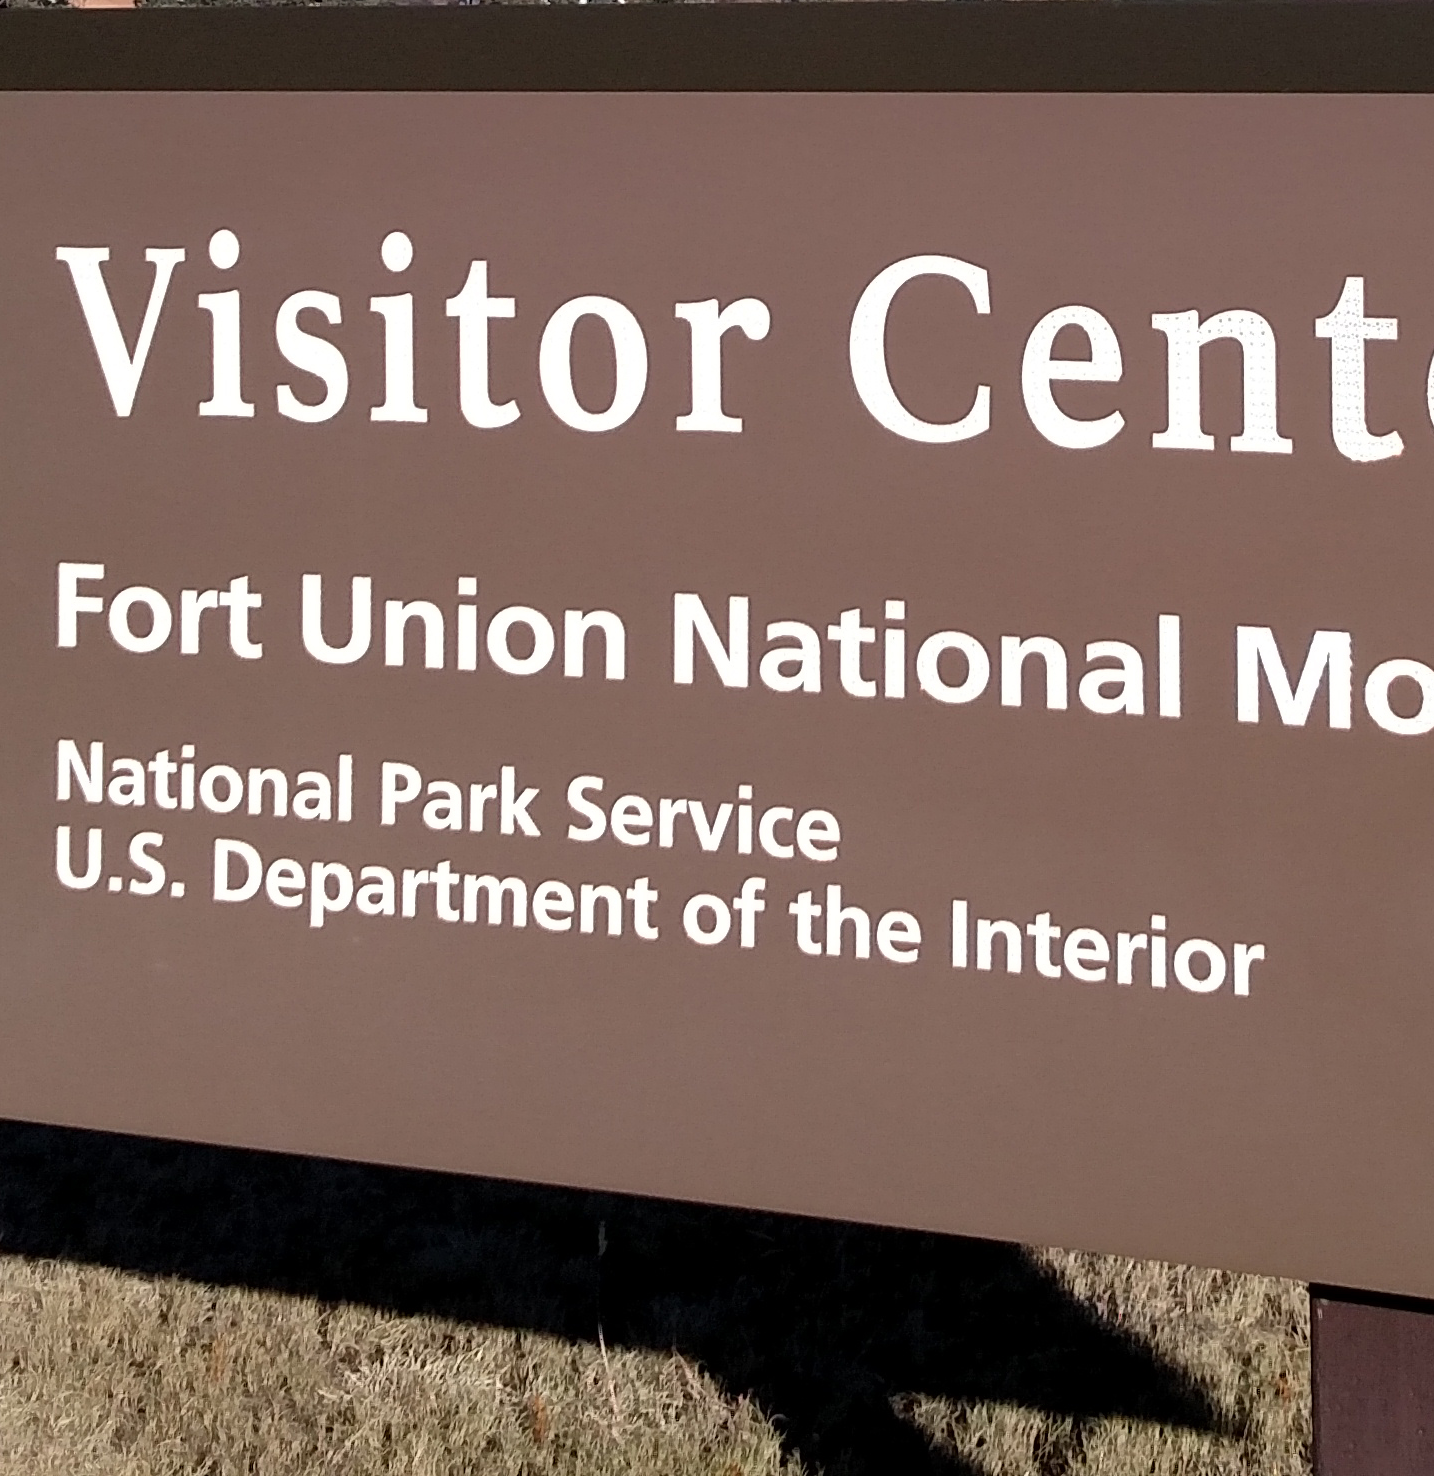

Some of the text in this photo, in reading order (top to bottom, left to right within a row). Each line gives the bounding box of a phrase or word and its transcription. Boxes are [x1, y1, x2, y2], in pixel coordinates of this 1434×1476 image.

[54, 228, 772, 434] Visitor
[56, 561, 264, 661] Fort
[301, 572, 627, 682] Union
[672, 591, 1182, 719] National
[55, 738, 842, 863] National Park Service
[55, 824, 1266, 997] U.S. Department of the Interior
